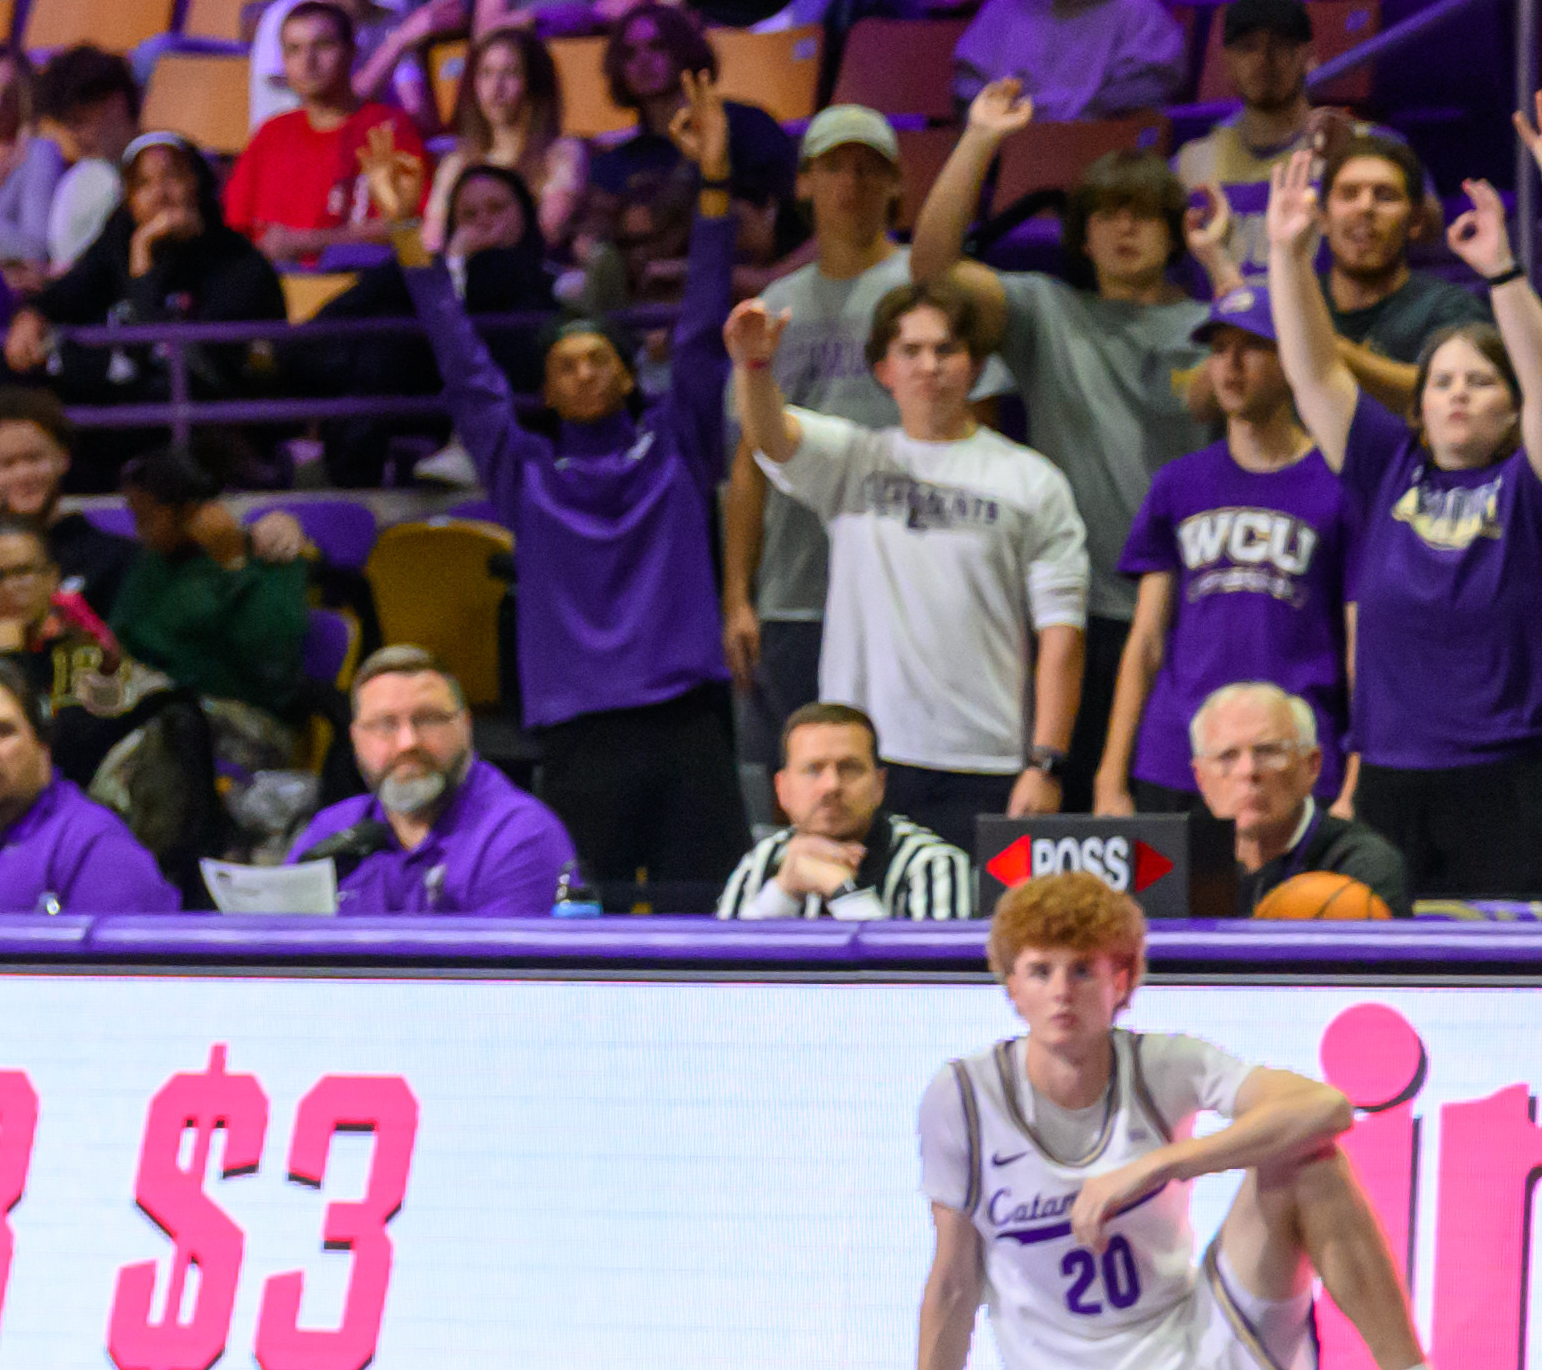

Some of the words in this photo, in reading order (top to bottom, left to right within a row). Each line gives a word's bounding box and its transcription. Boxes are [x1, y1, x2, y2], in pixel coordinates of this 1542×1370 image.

[1177, 507, 1320, 576] WCU
[1031, 835, 1131, 893] POSS
[1061, 1233, 1142, 1316] 20
